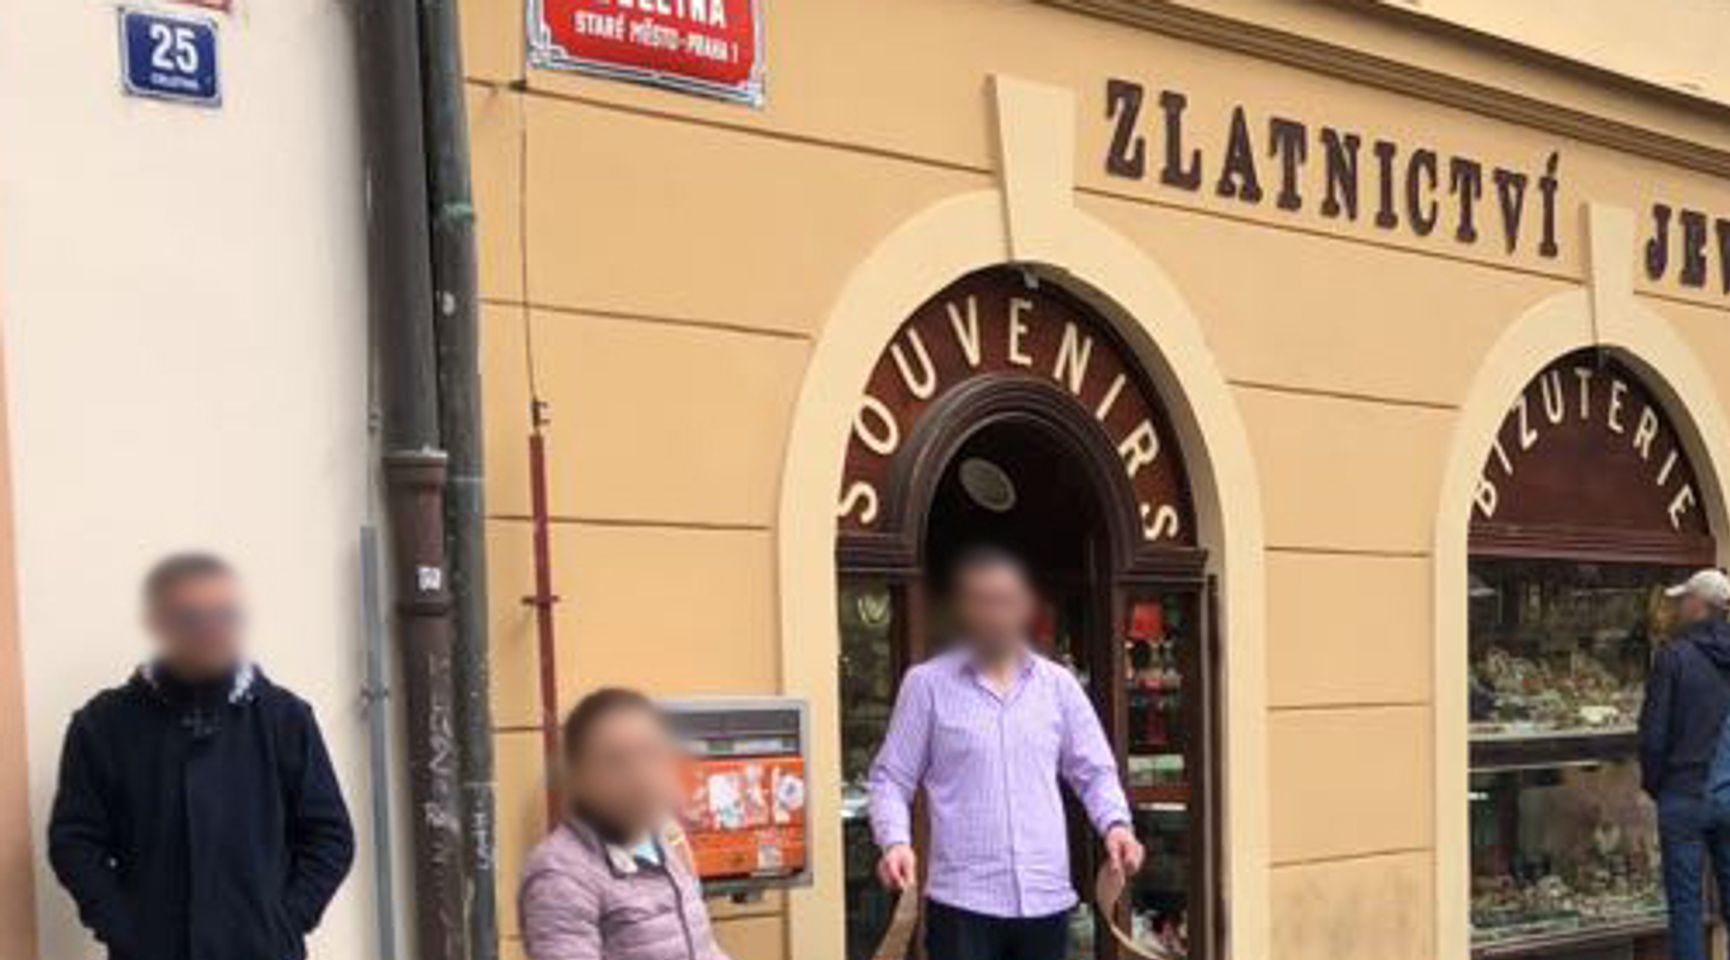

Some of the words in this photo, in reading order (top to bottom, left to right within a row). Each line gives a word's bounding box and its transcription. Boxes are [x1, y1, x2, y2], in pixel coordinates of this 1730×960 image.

[150, 23, 199, 74] 25
[574, 10, 625, 42] STARÉ
[732, 42, 739, 64] 1
[1105, 78, 1560, 258] ZLATNICTVÍ
[837, 295, 1179, 541] SOUVENIRS
